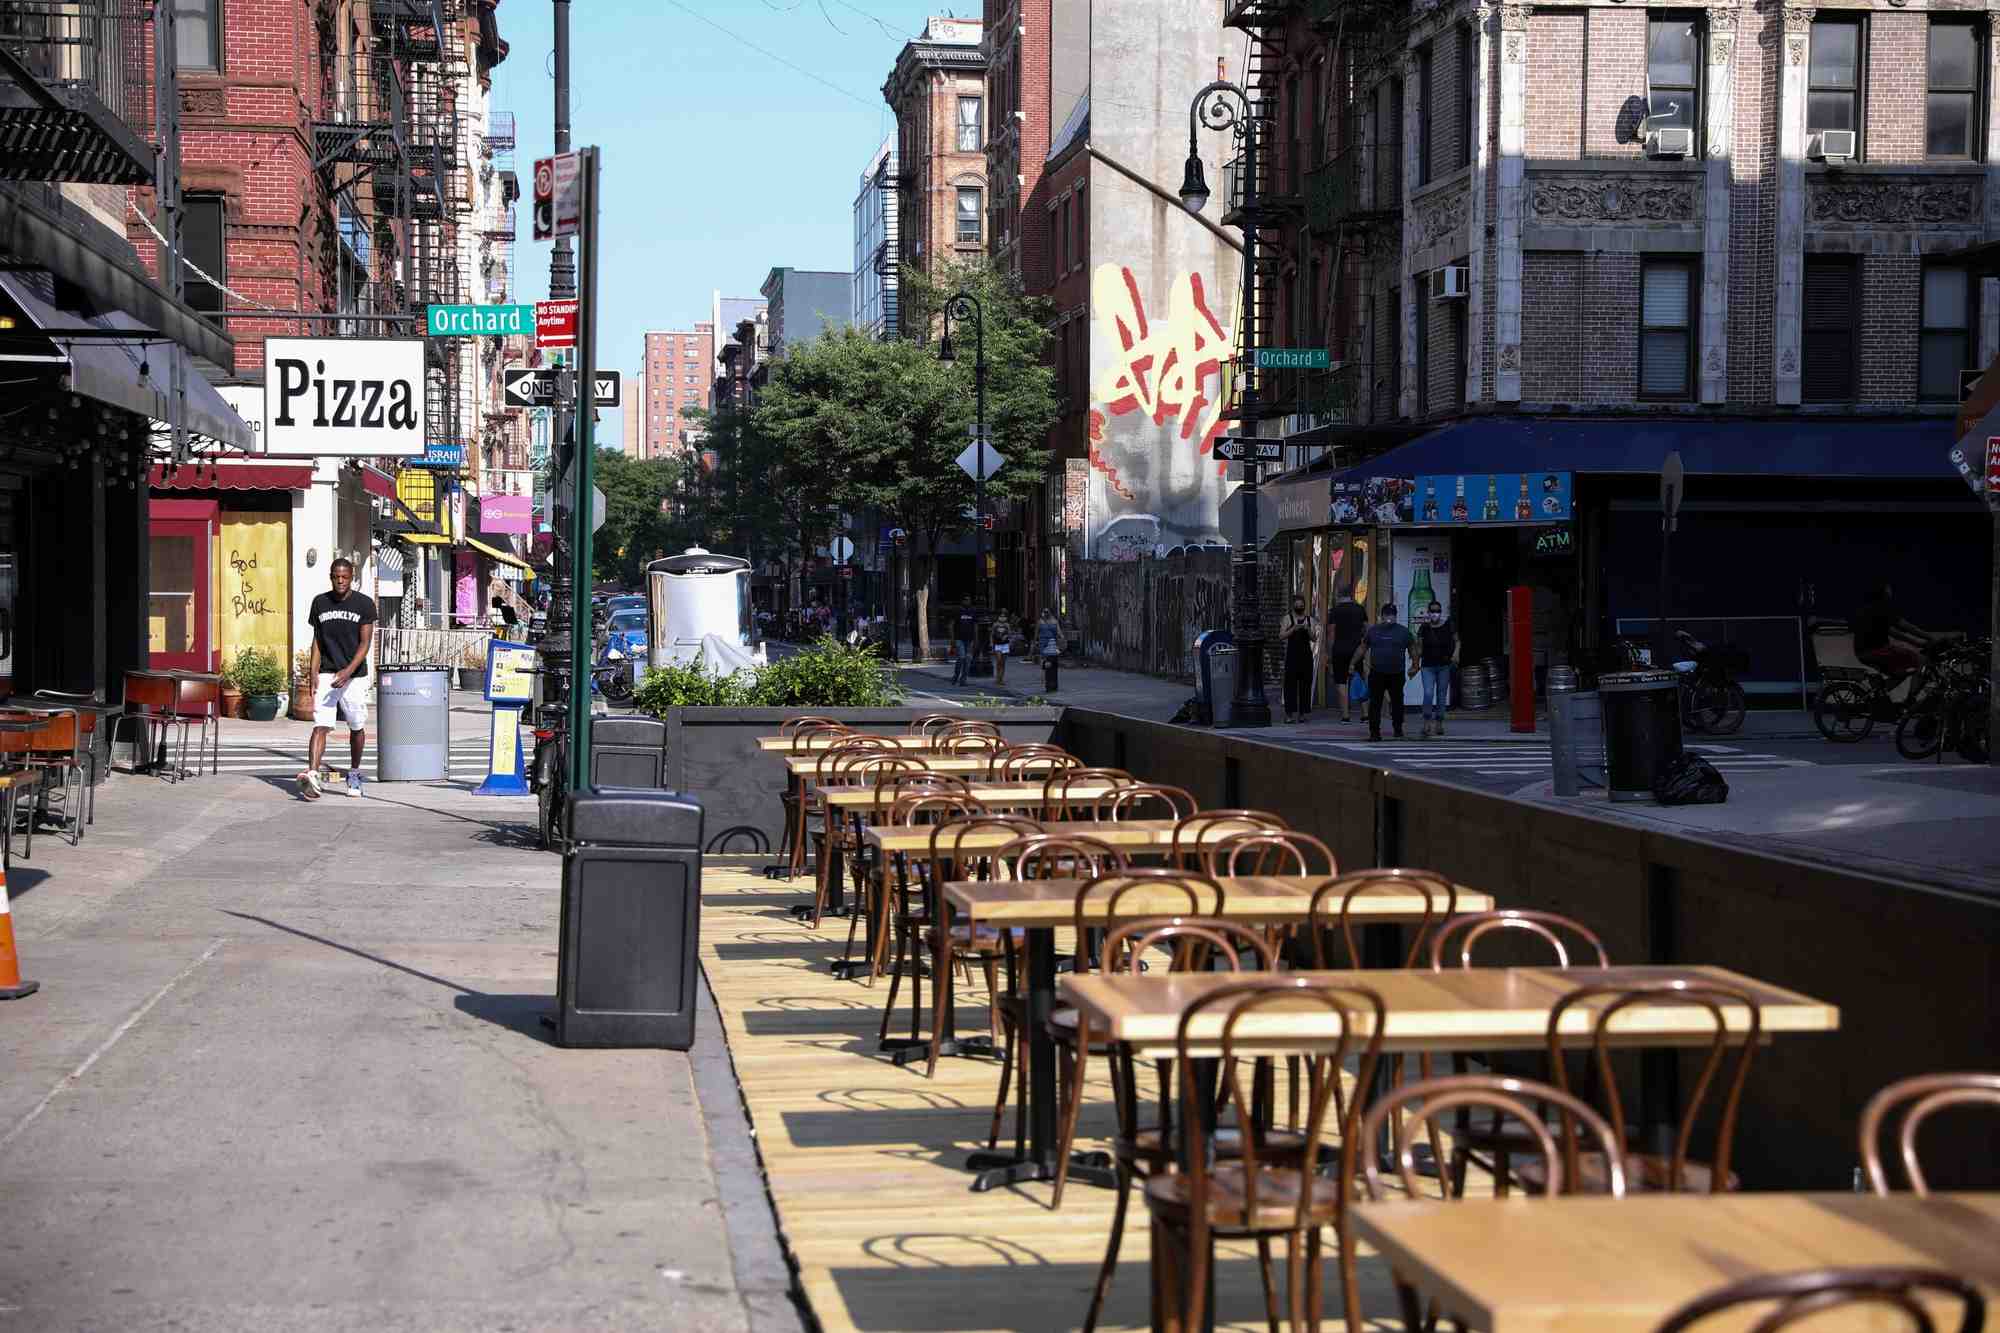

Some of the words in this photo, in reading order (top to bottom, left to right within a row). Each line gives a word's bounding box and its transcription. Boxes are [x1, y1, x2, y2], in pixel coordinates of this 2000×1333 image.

[538, 306, 548, 315] NO
[435, 307, 521, 331] Orchard
[538, 316, 565, 326] Anytime
[1260, 351, 1312, 366] Orchard
[274, 358, 418, 430] Pizza
[520, 380, 551, 396] ONE
[1224, 444, 1246, 455] ONE
[1536, 531, 1571, 550] ATM
[230, 549, 257, 572] God
[241, 575, 254, 593] is
[318, 610, 361, 624] BROOKLYN
